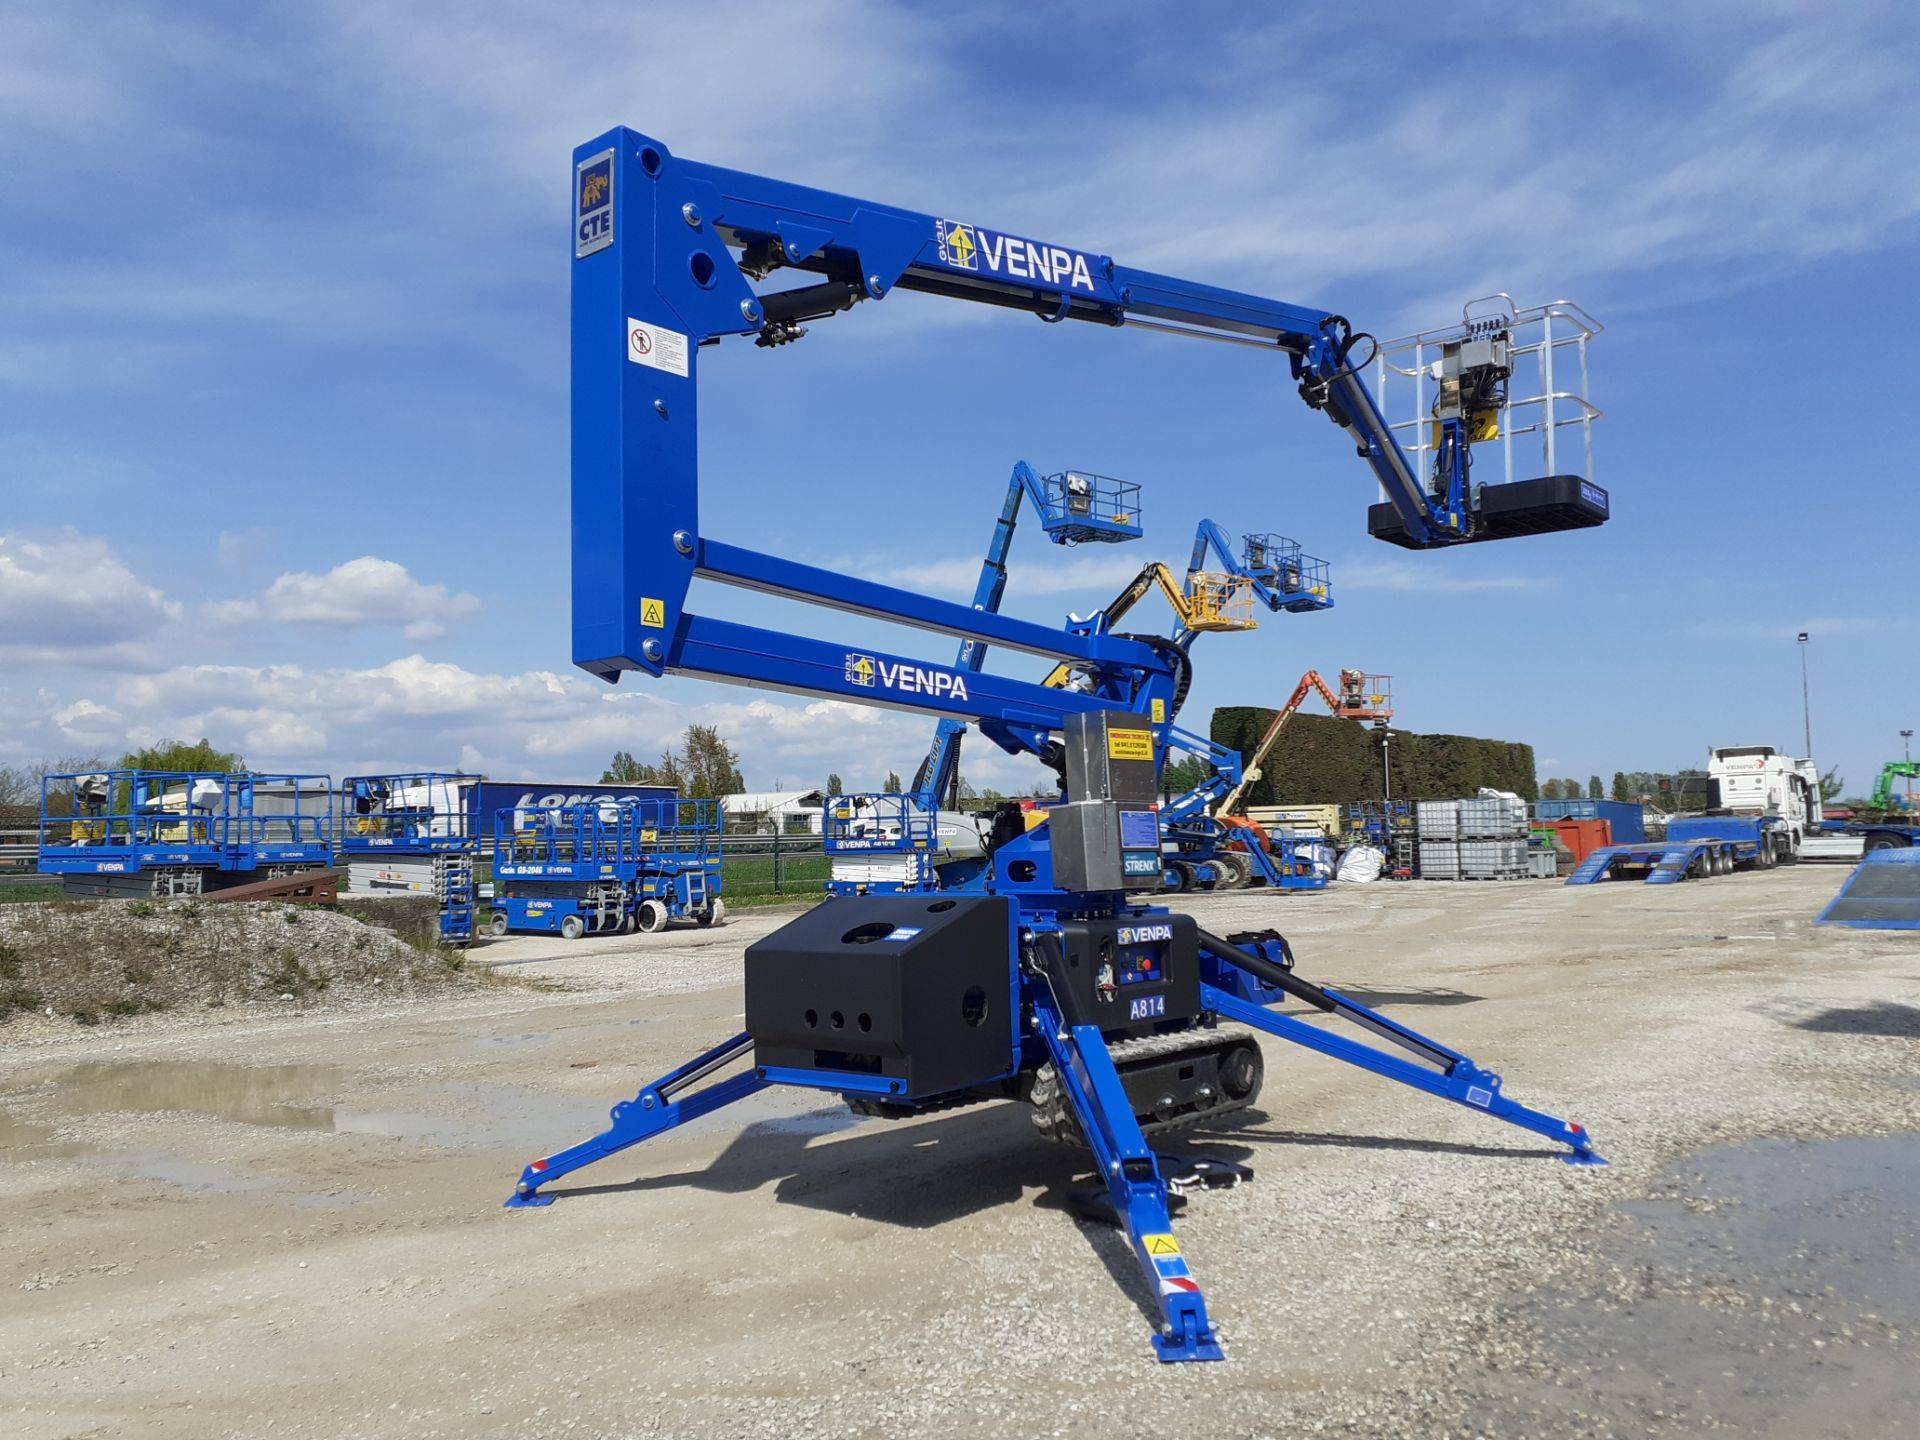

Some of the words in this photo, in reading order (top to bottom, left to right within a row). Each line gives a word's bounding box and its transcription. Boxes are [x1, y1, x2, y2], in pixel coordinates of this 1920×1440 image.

[579, 209, 611, 241] CTE
[977, 231, 1096, 291] VENPA
[878, 660, 969, 701] VENPA
[845, 841, 871, 849] VENPA
[103, 863, 124, 872] VENPA
[1125, 860, 1155, 872] STRENX
[1131, 926, 1172, 942] VENPA
[1130, 996, 1165, 1020] A814
